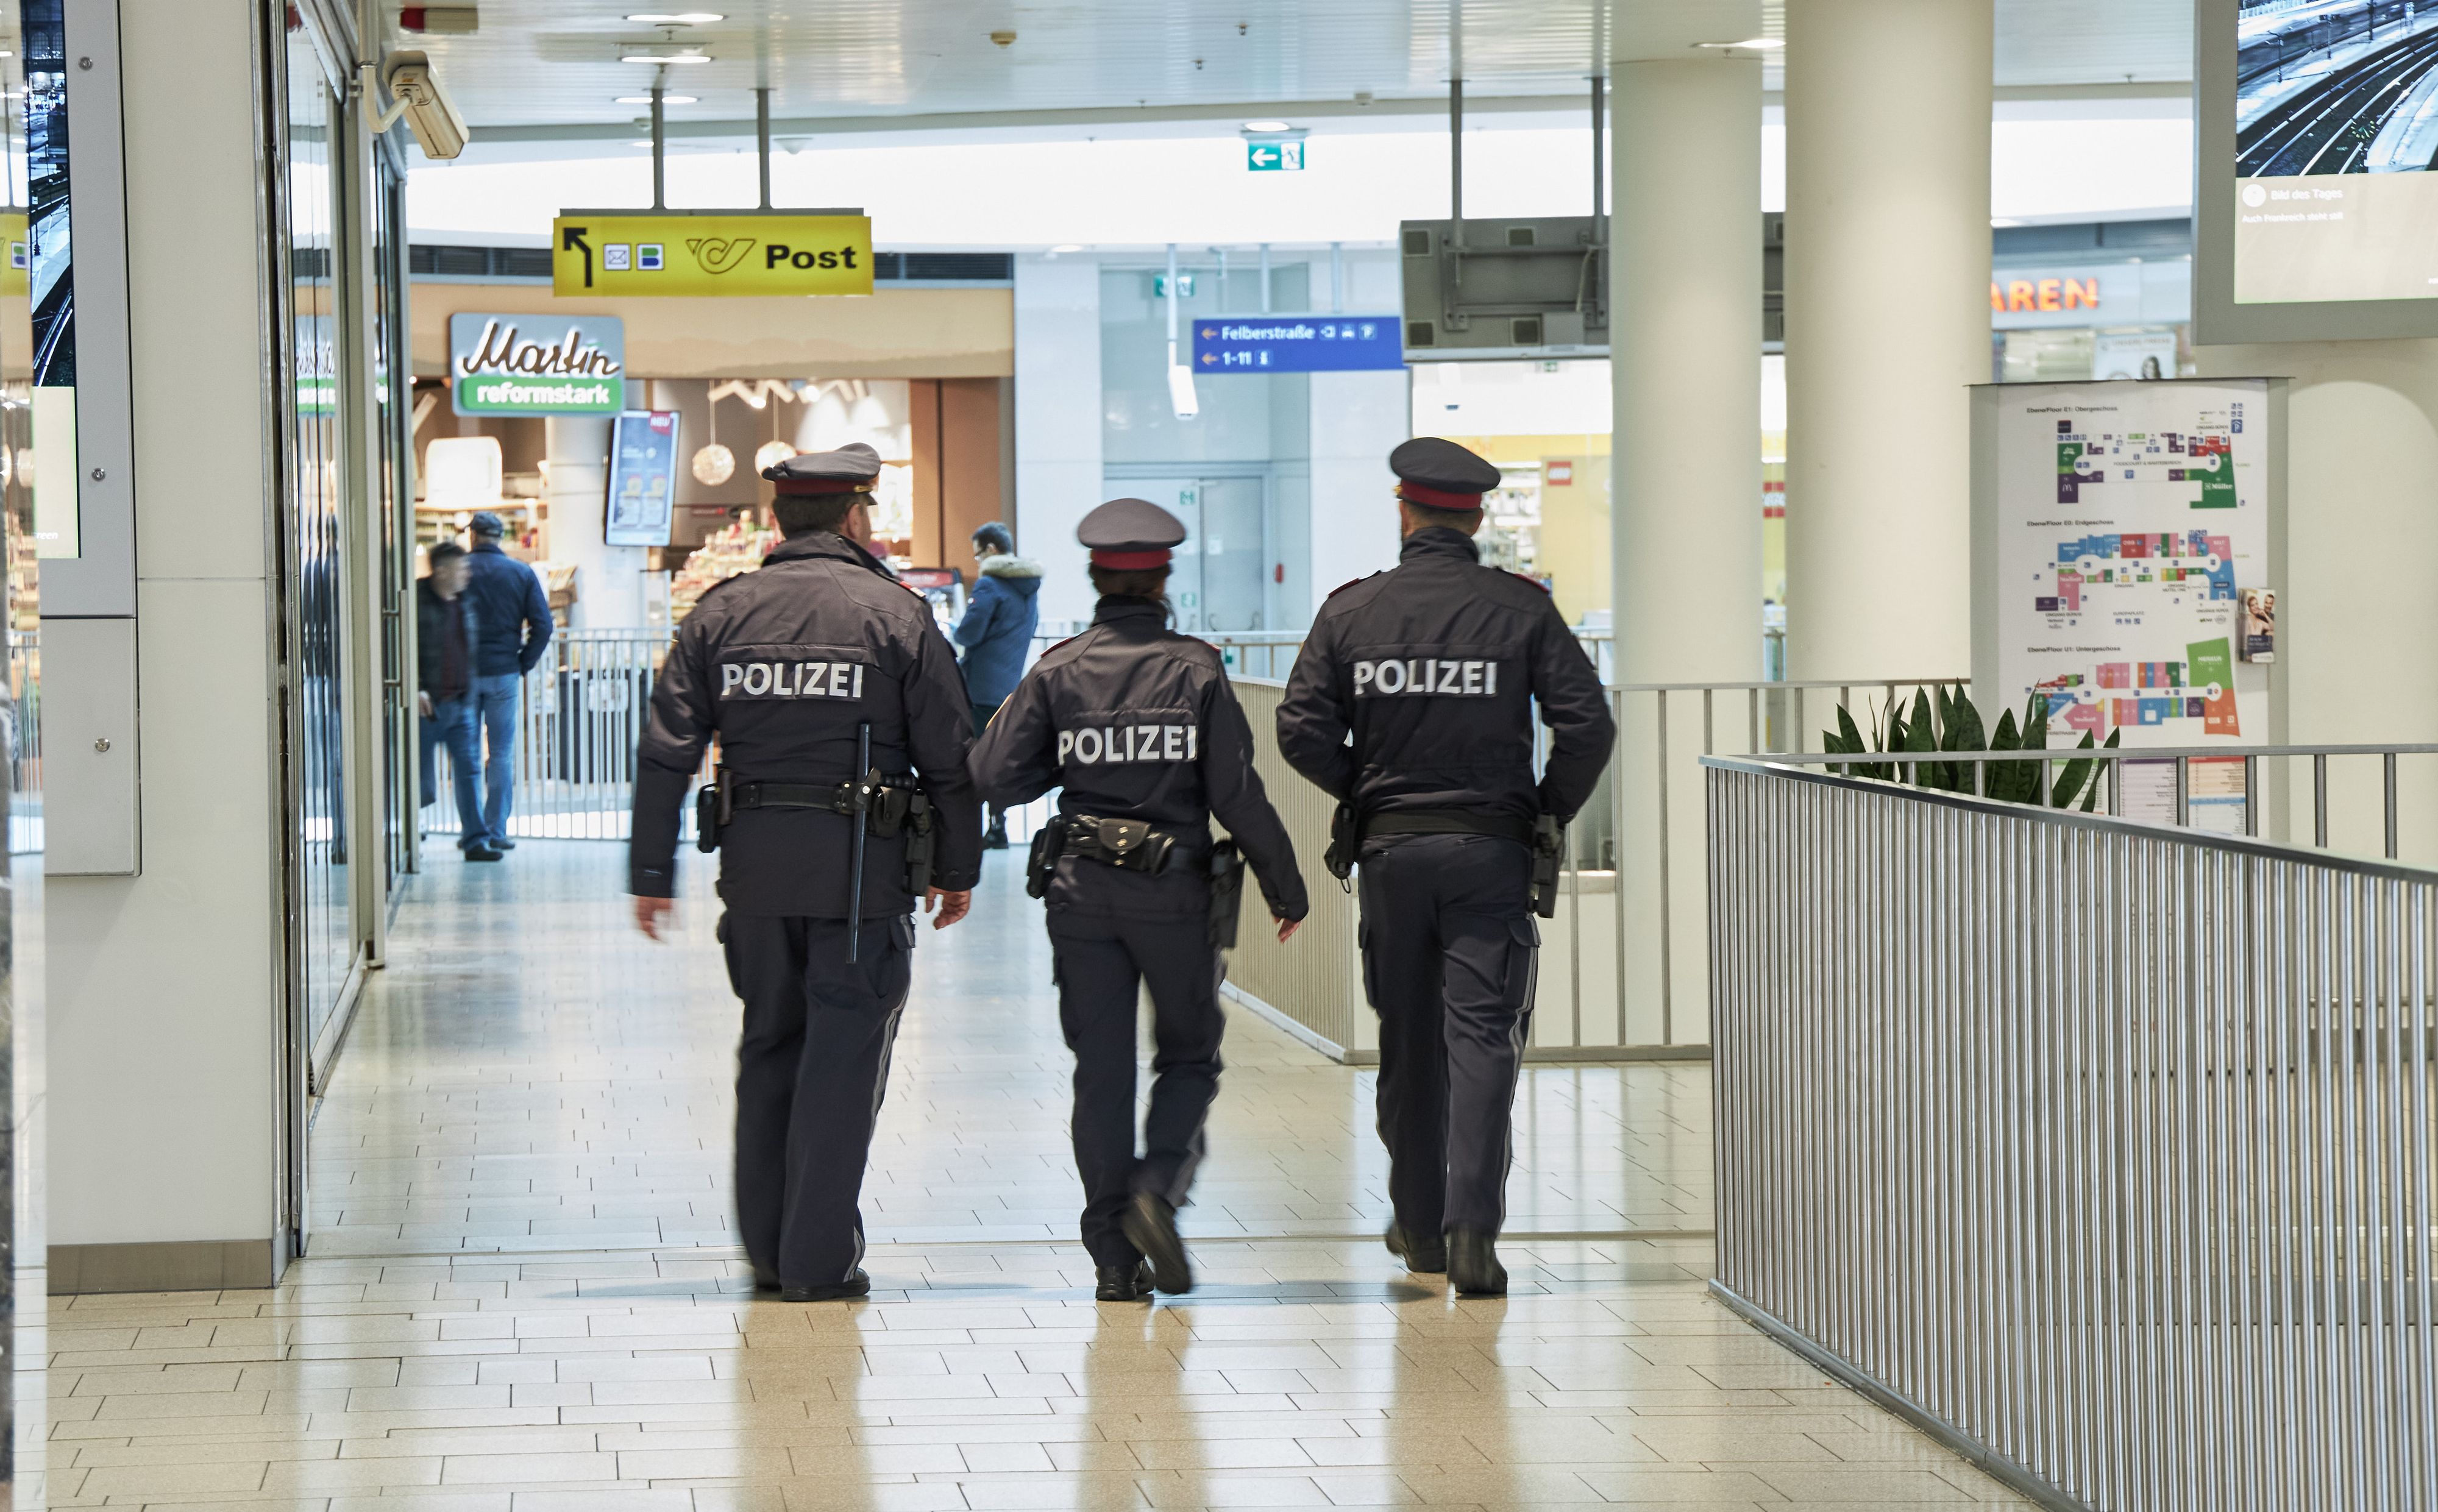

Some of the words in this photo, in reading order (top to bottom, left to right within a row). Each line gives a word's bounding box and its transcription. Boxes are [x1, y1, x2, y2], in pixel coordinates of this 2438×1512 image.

[2271, 190, 2289, 200] Bild
[2292, 190, 2310, 199] des
[2312, 188, 2344, 201] Tages
[2264, 213, 2305, 222] Frankreich
[766, 244, 857, 269] Post
[1221, 324, 1316, 340] Felberstraße
[457, 318, 620, 378] Martin
[1222, 350, 1253, 366] 1-11
[477, 382, 610, 404] reformstark
[722, 662, 863, 698] POLIZEI
[1354, 659, 1497, 695] POLIZEI
[1058, 725, 1196, 766] POLIZEI
